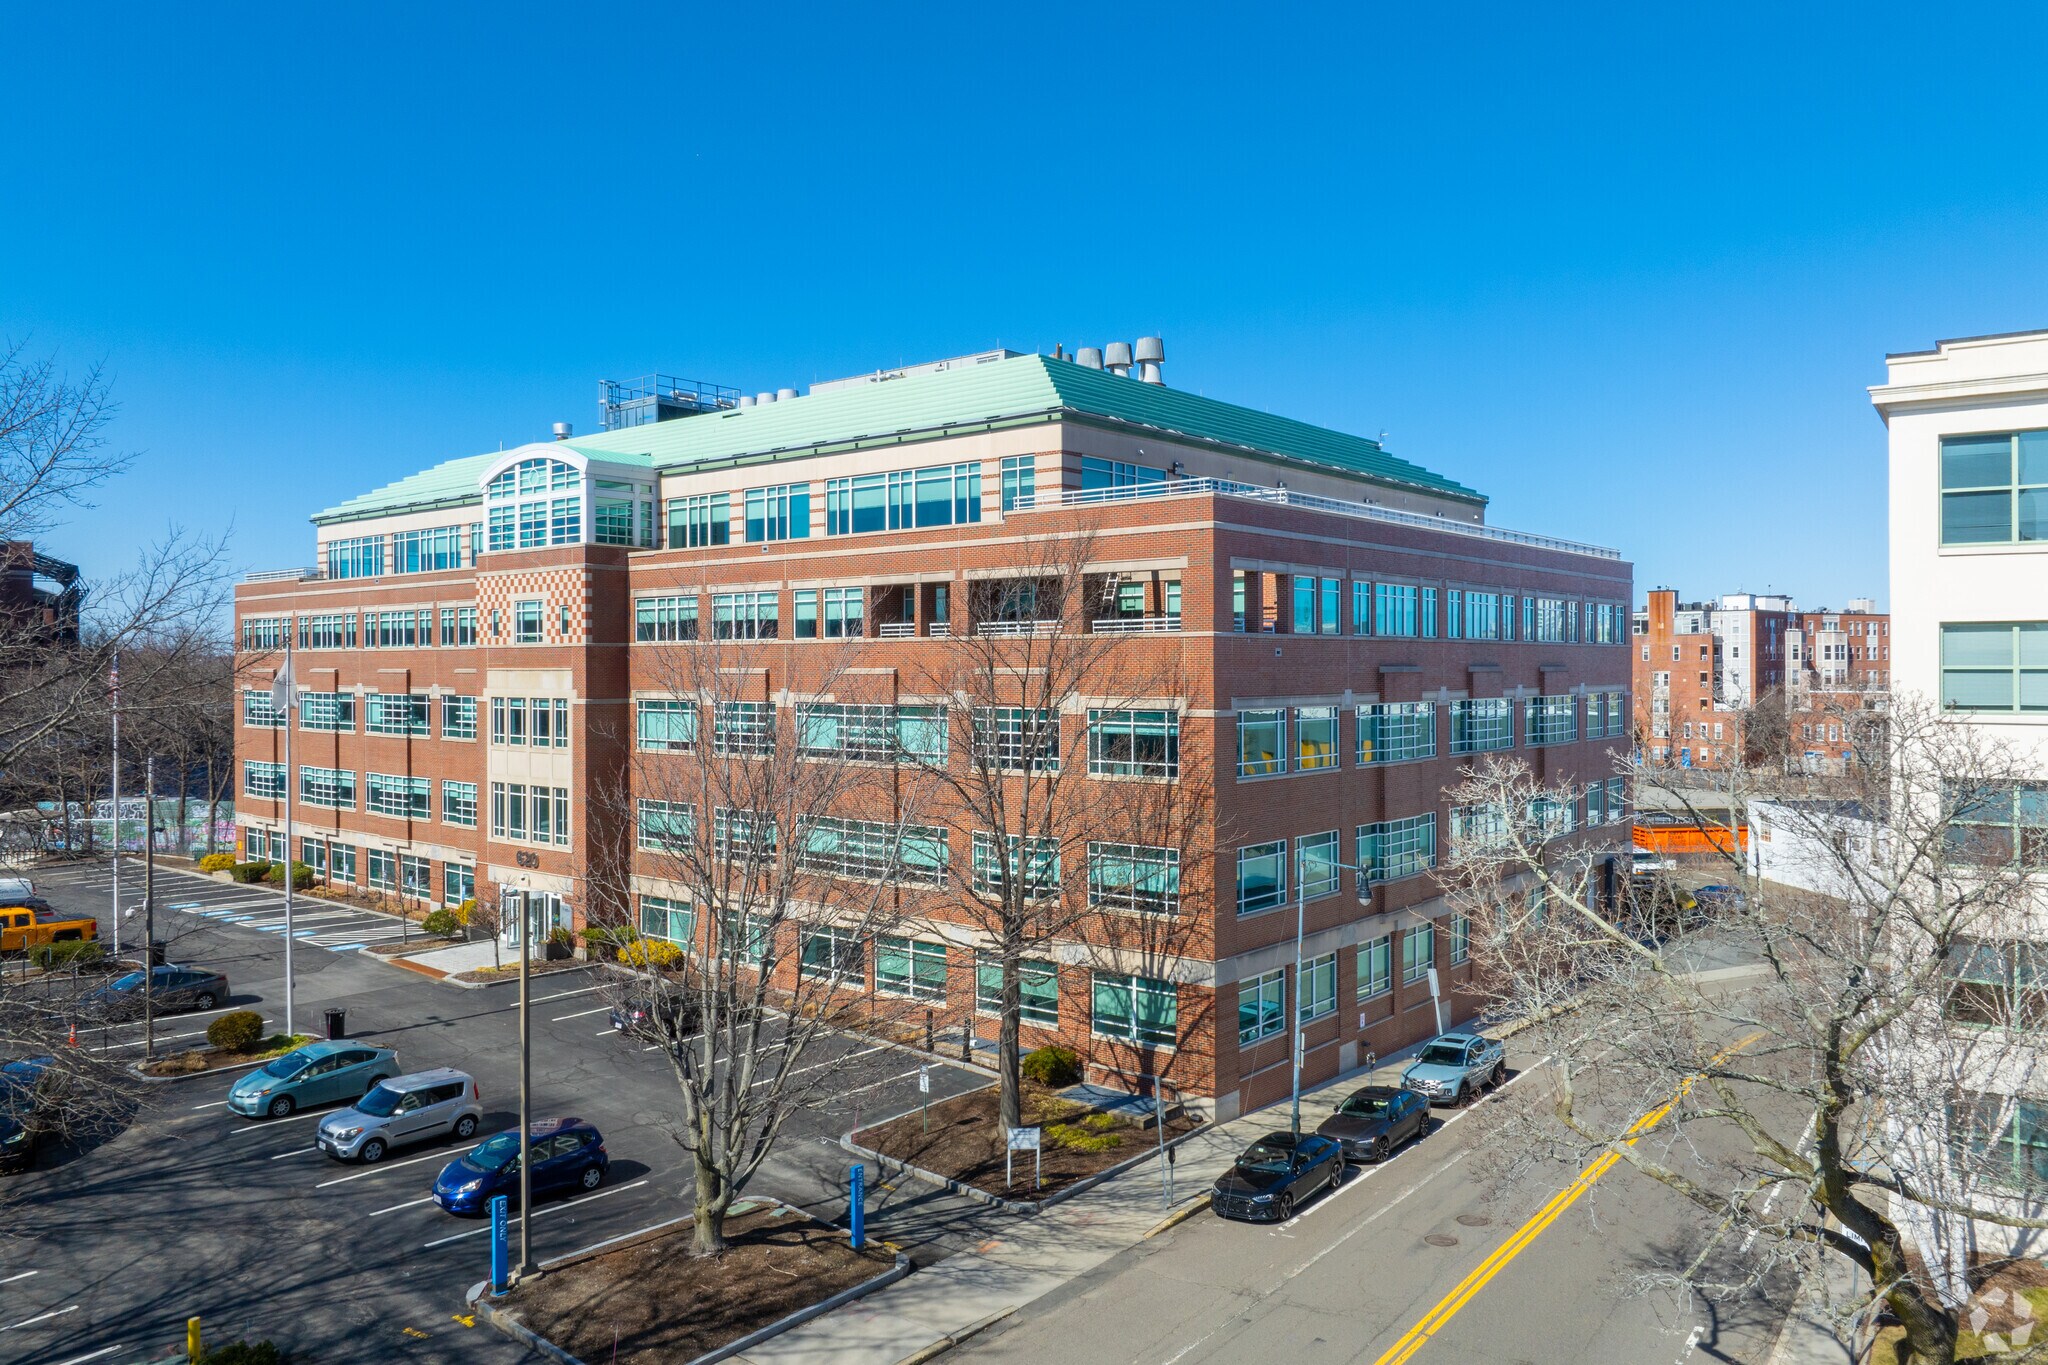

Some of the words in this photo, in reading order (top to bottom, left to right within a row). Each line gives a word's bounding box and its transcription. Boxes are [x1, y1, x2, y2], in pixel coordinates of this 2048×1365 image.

[516, 850, 539, 868] 620
[499, 1200, 507, 1218] EXIT
[499, 1220, 507, 1242] ONLY
